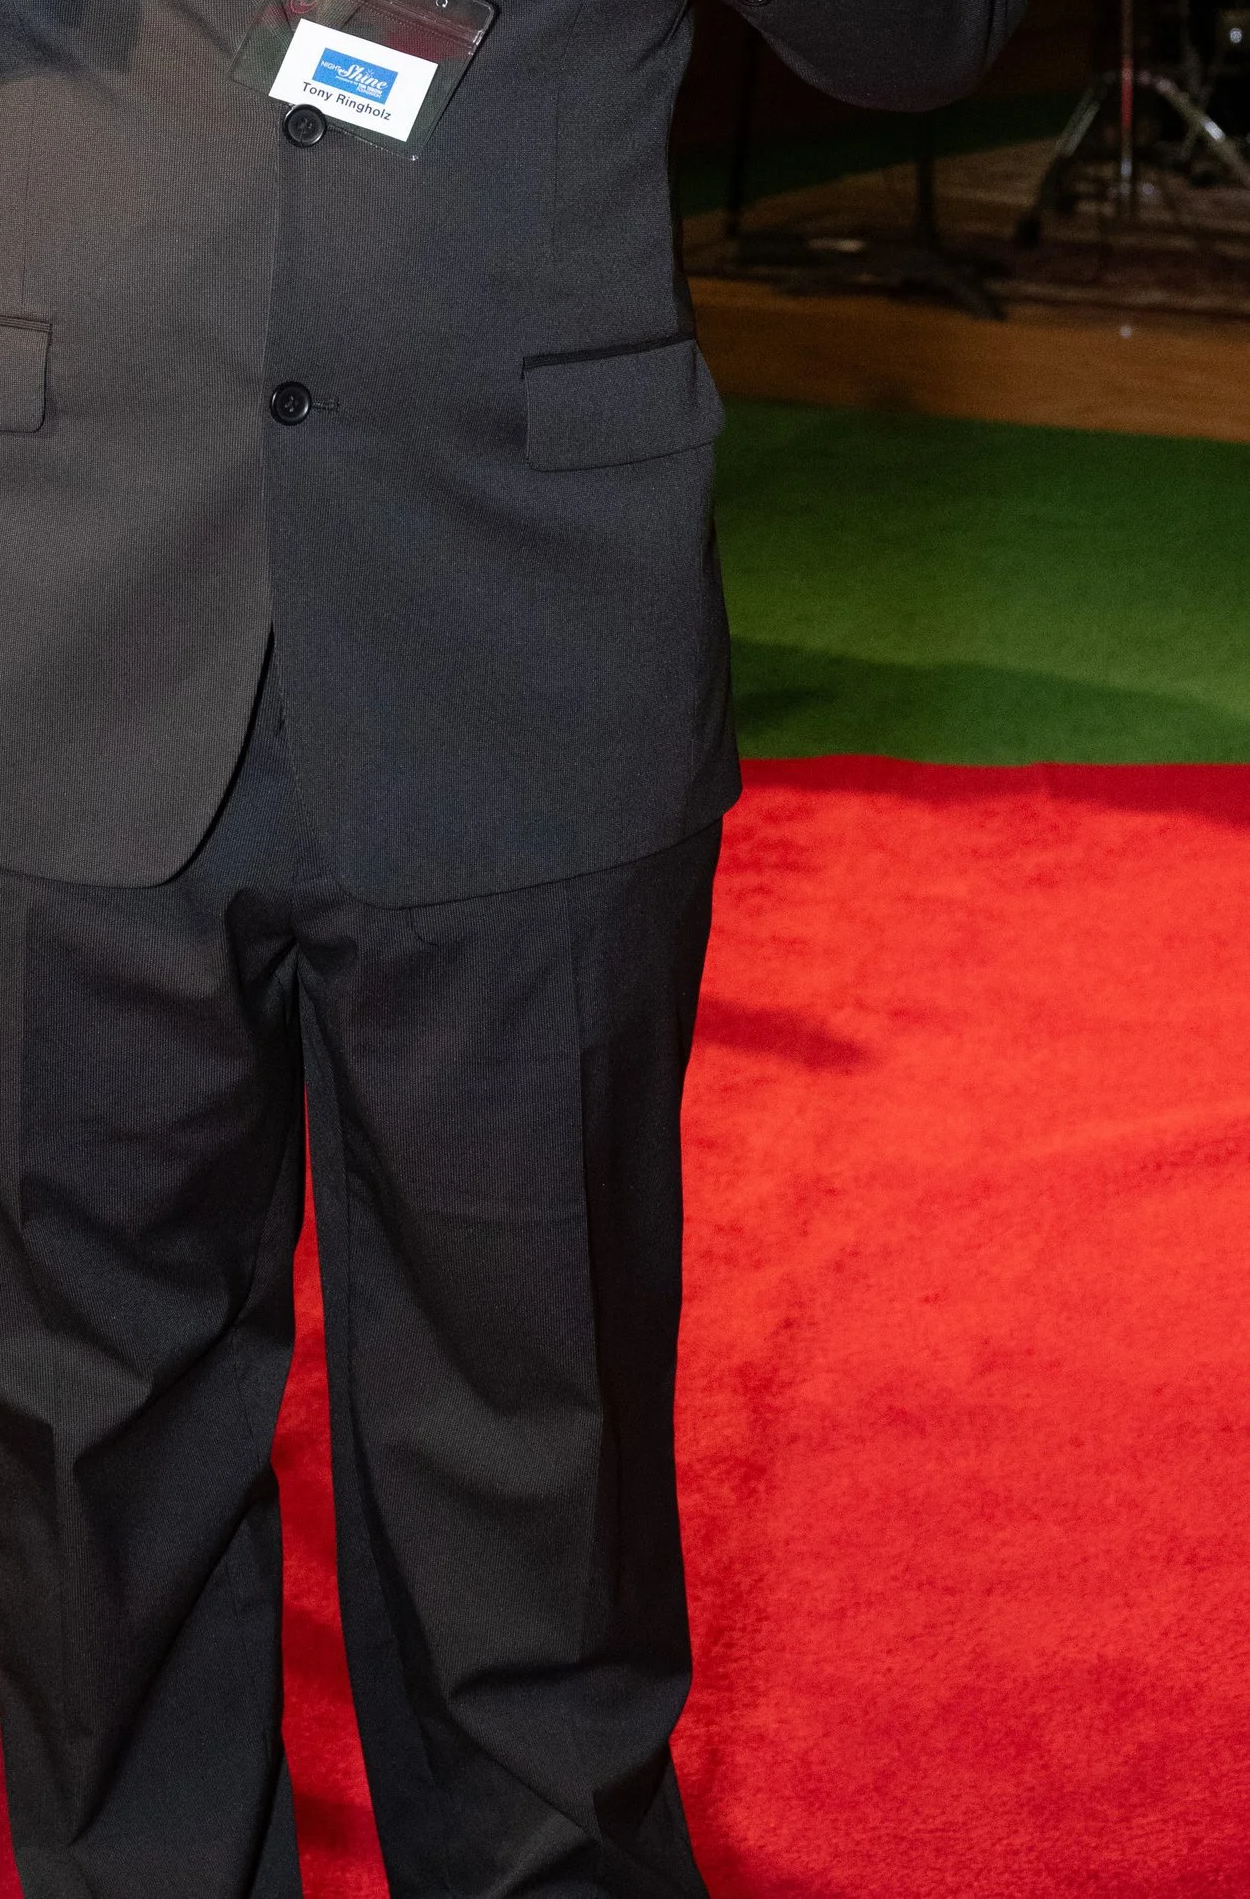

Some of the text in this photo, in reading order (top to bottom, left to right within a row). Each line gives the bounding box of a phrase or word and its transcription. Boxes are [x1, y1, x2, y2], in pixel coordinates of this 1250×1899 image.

[338, 64, 388, 89] Shine
[303, 81, 333, 101] Tony
[336, 94, 392, 121] Ringholz
